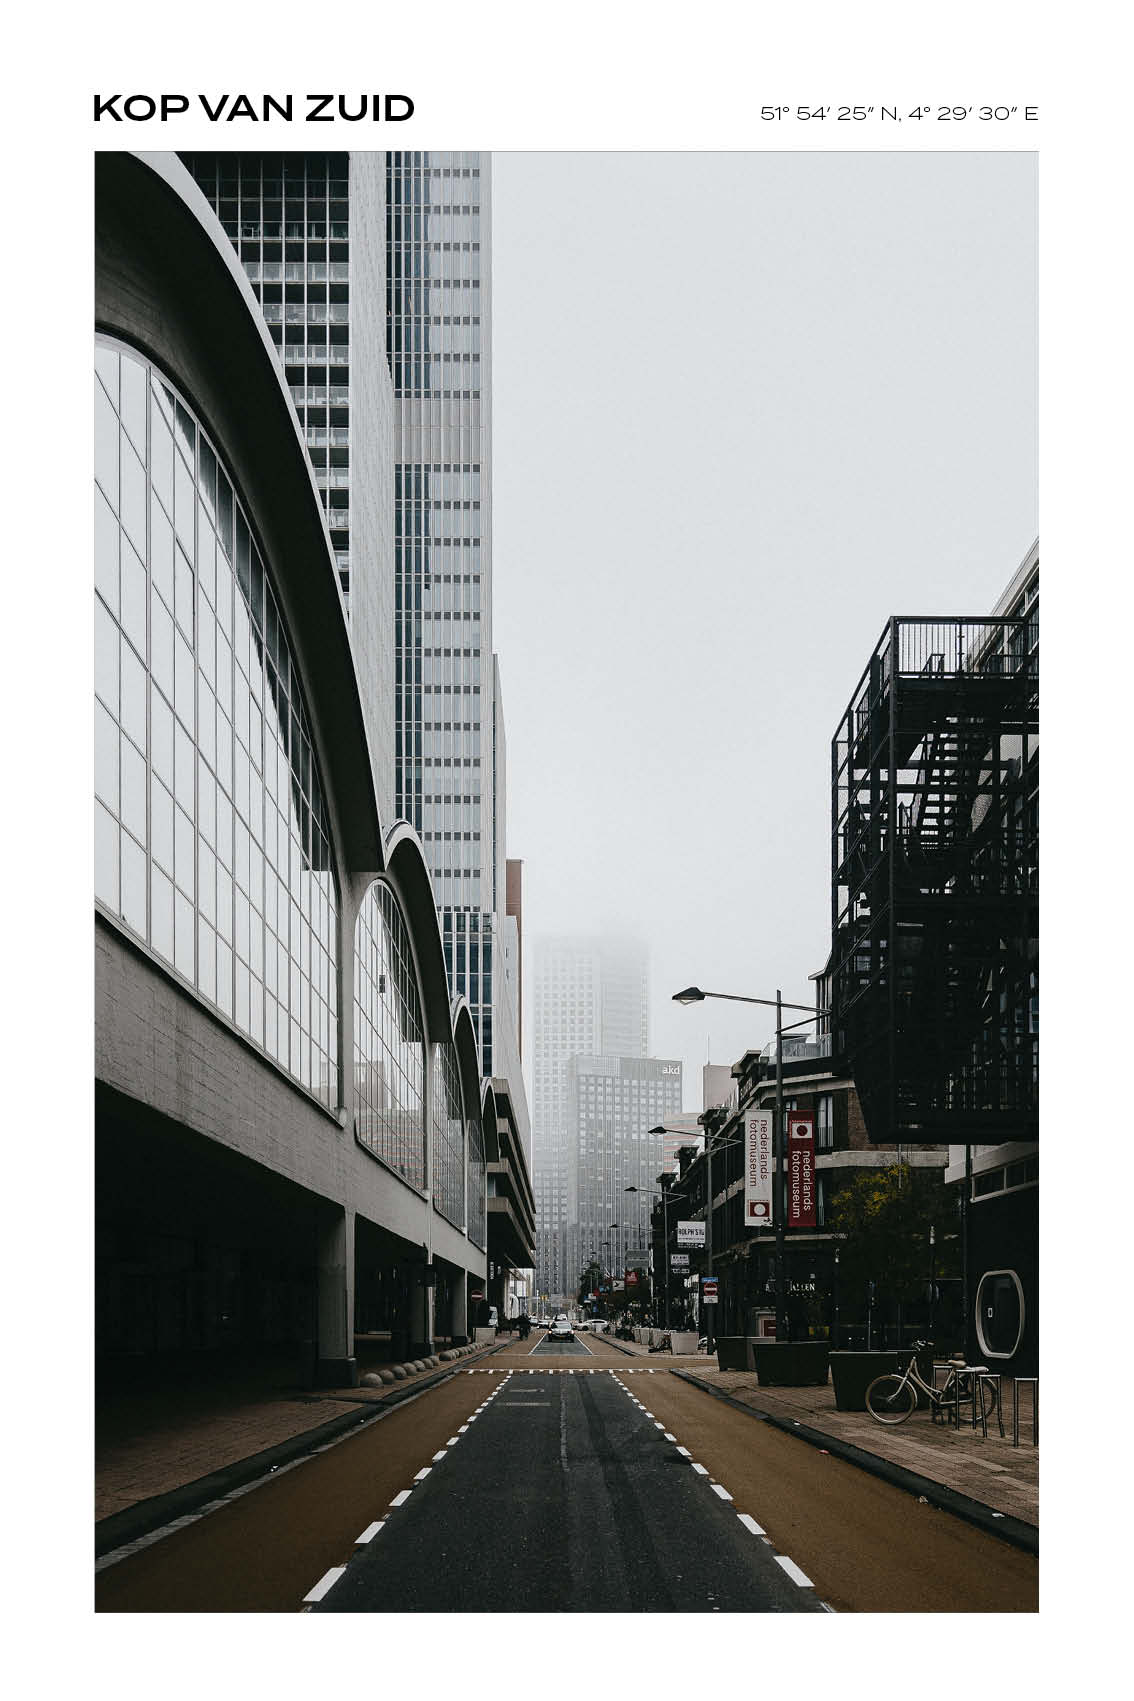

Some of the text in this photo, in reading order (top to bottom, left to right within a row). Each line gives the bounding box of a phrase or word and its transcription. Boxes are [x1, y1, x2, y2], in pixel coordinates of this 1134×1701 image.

[663, 1065, 681, 1075] akd
[749, 1119, 759, 1187] fotomuseum
[760, 1120, 770, 1180] nederlands
[792, 1150, 802, 1218] fotomuseum
[803, 1151, 813, 1211] nederlands
